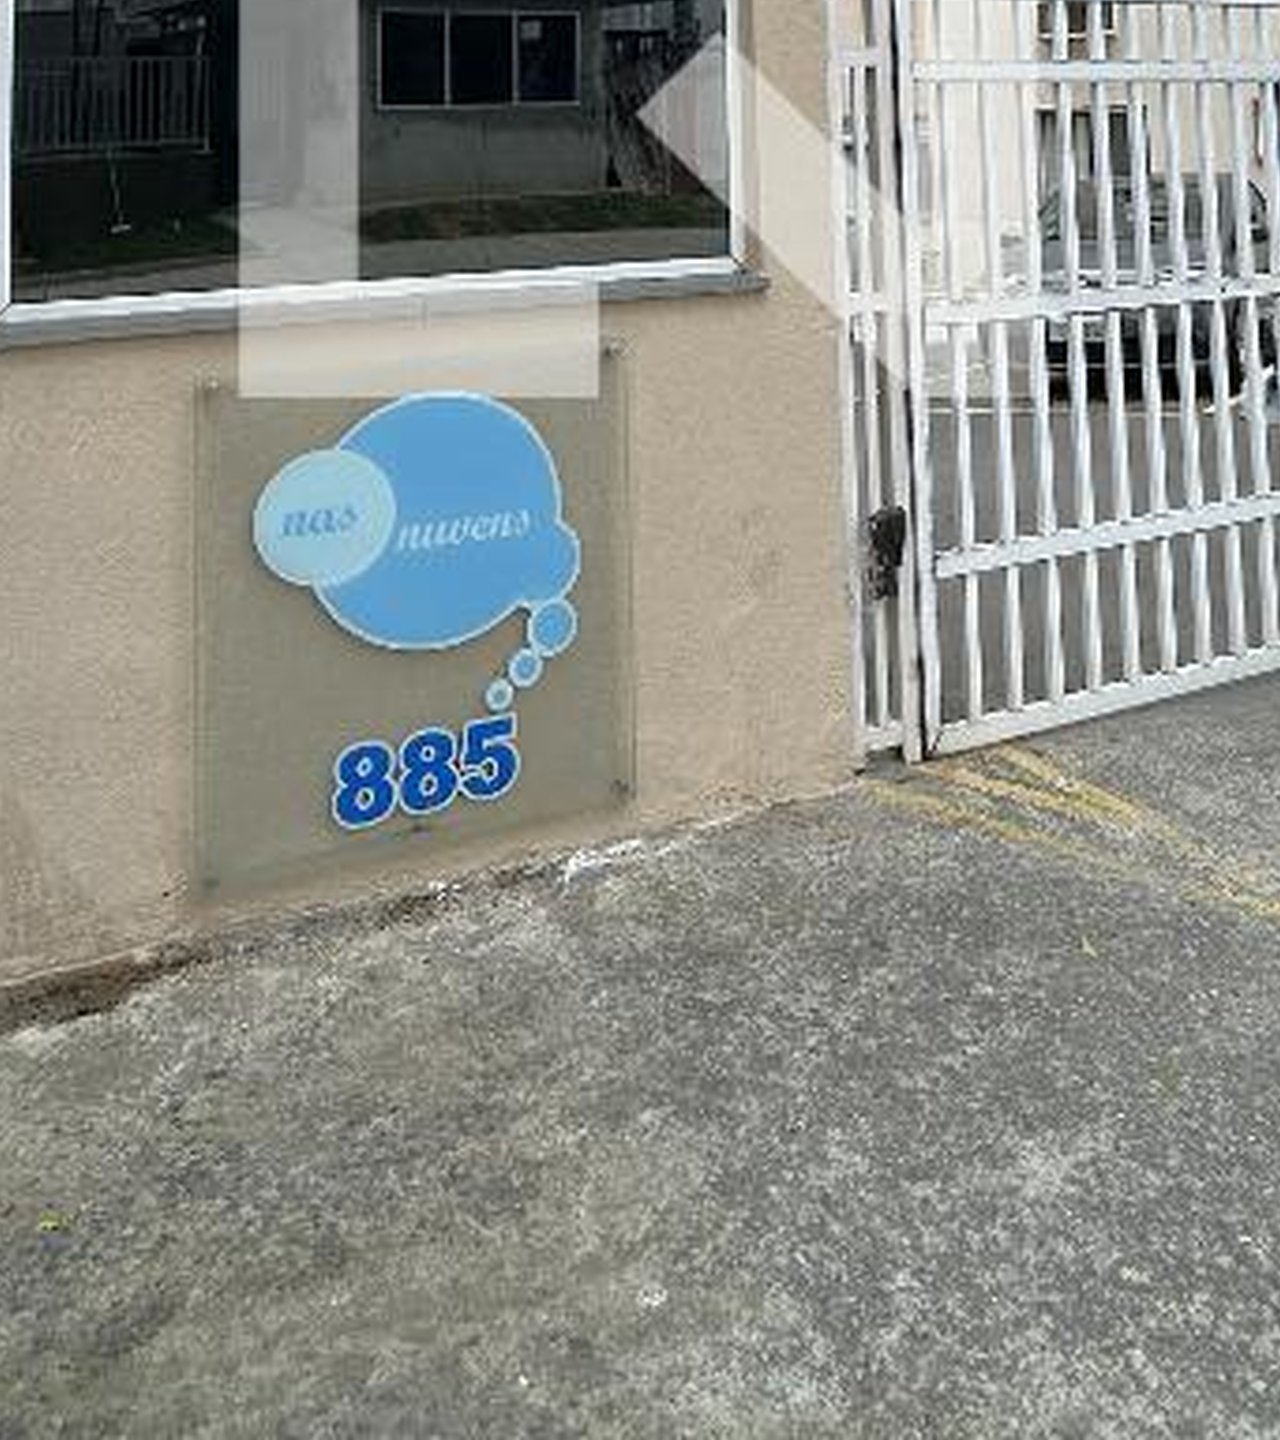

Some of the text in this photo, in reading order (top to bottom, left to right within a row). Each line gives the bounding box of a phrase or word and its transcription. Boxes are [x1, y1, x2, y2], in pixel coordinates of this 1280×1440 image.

[282, 505, 530, 553] nas nuvens
[332, 713, 521, 829] 885
